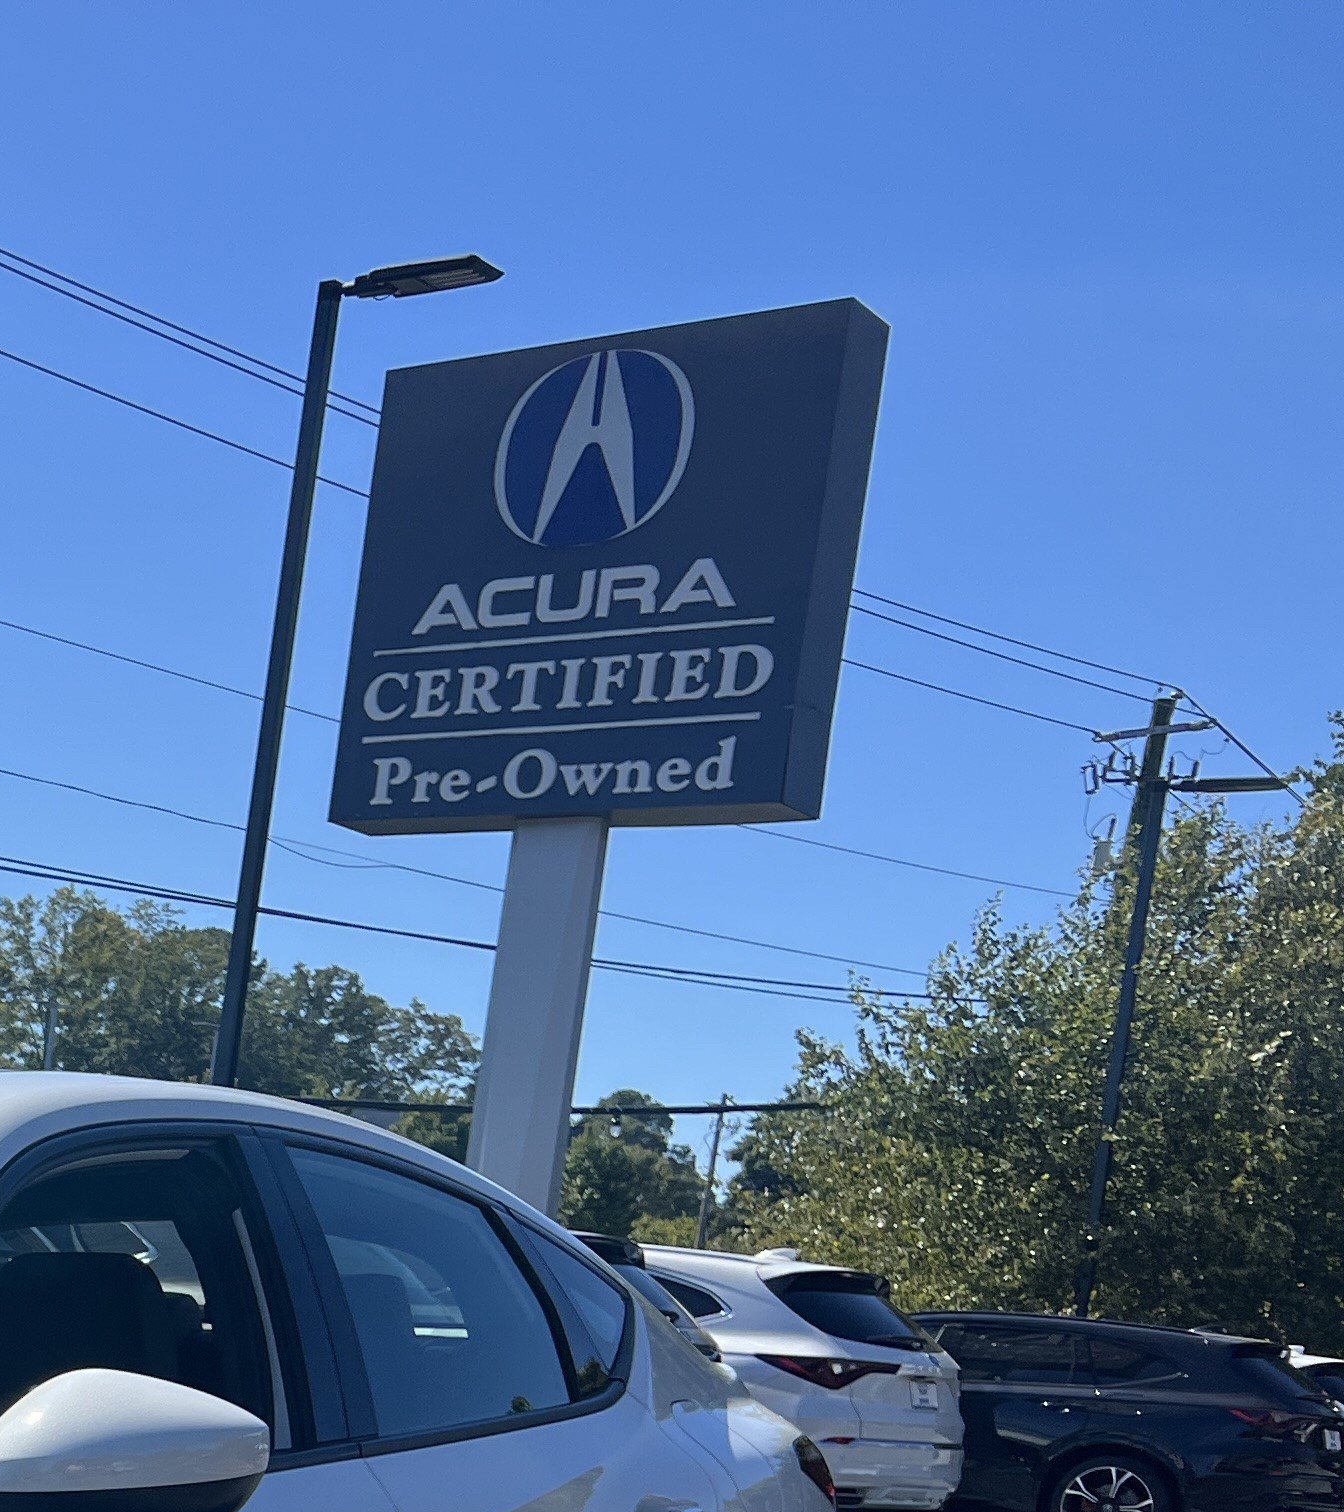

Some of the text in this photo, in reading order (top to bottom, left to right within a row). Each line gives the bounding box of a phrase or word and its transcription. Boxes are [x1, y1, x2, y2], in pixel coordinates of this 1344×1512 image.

[412, 557, 736, 635] ACURA
[362, 643, 775, 722] CERTIFIED
[368, 735, 737, 807] Pre-Owned
